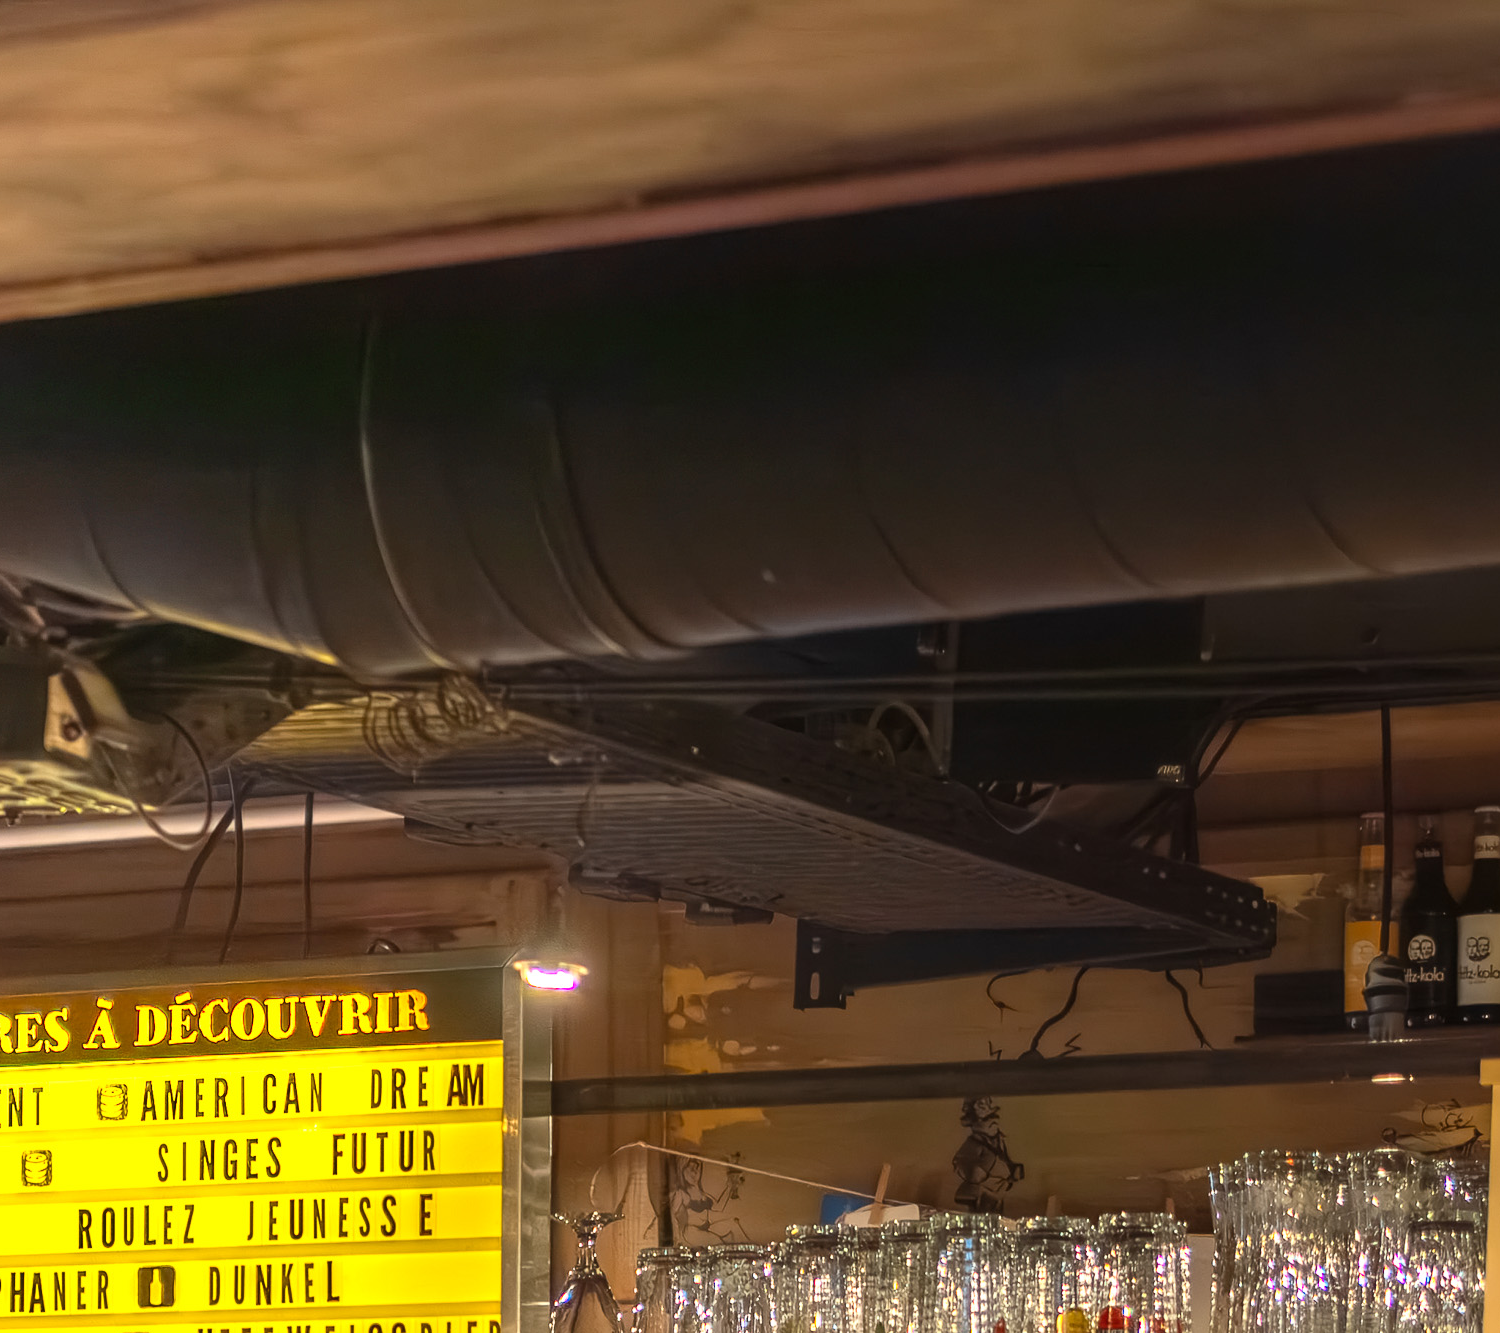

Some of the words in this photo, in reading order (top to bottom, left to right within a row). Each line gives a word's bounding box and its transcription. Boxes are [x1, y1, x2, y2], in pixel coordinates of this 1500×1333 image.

[82, 997, 121, 1050] À
[134, 988, 431, 1048] DÉCOUVRIR
[140, 1070, 323, 1122] AMERICAN
[370, 1063, 486, 1110] DREAM
[157, 1136, 282, 1183] SINGES
[332, 1130, 436, 1176] FUTUR
[78, 1203, 195, 1250] ROULEZ
[246, 1193, 434, 1242] JEUNESSE
[208, 1260, 340, 1307] DUNKEL
